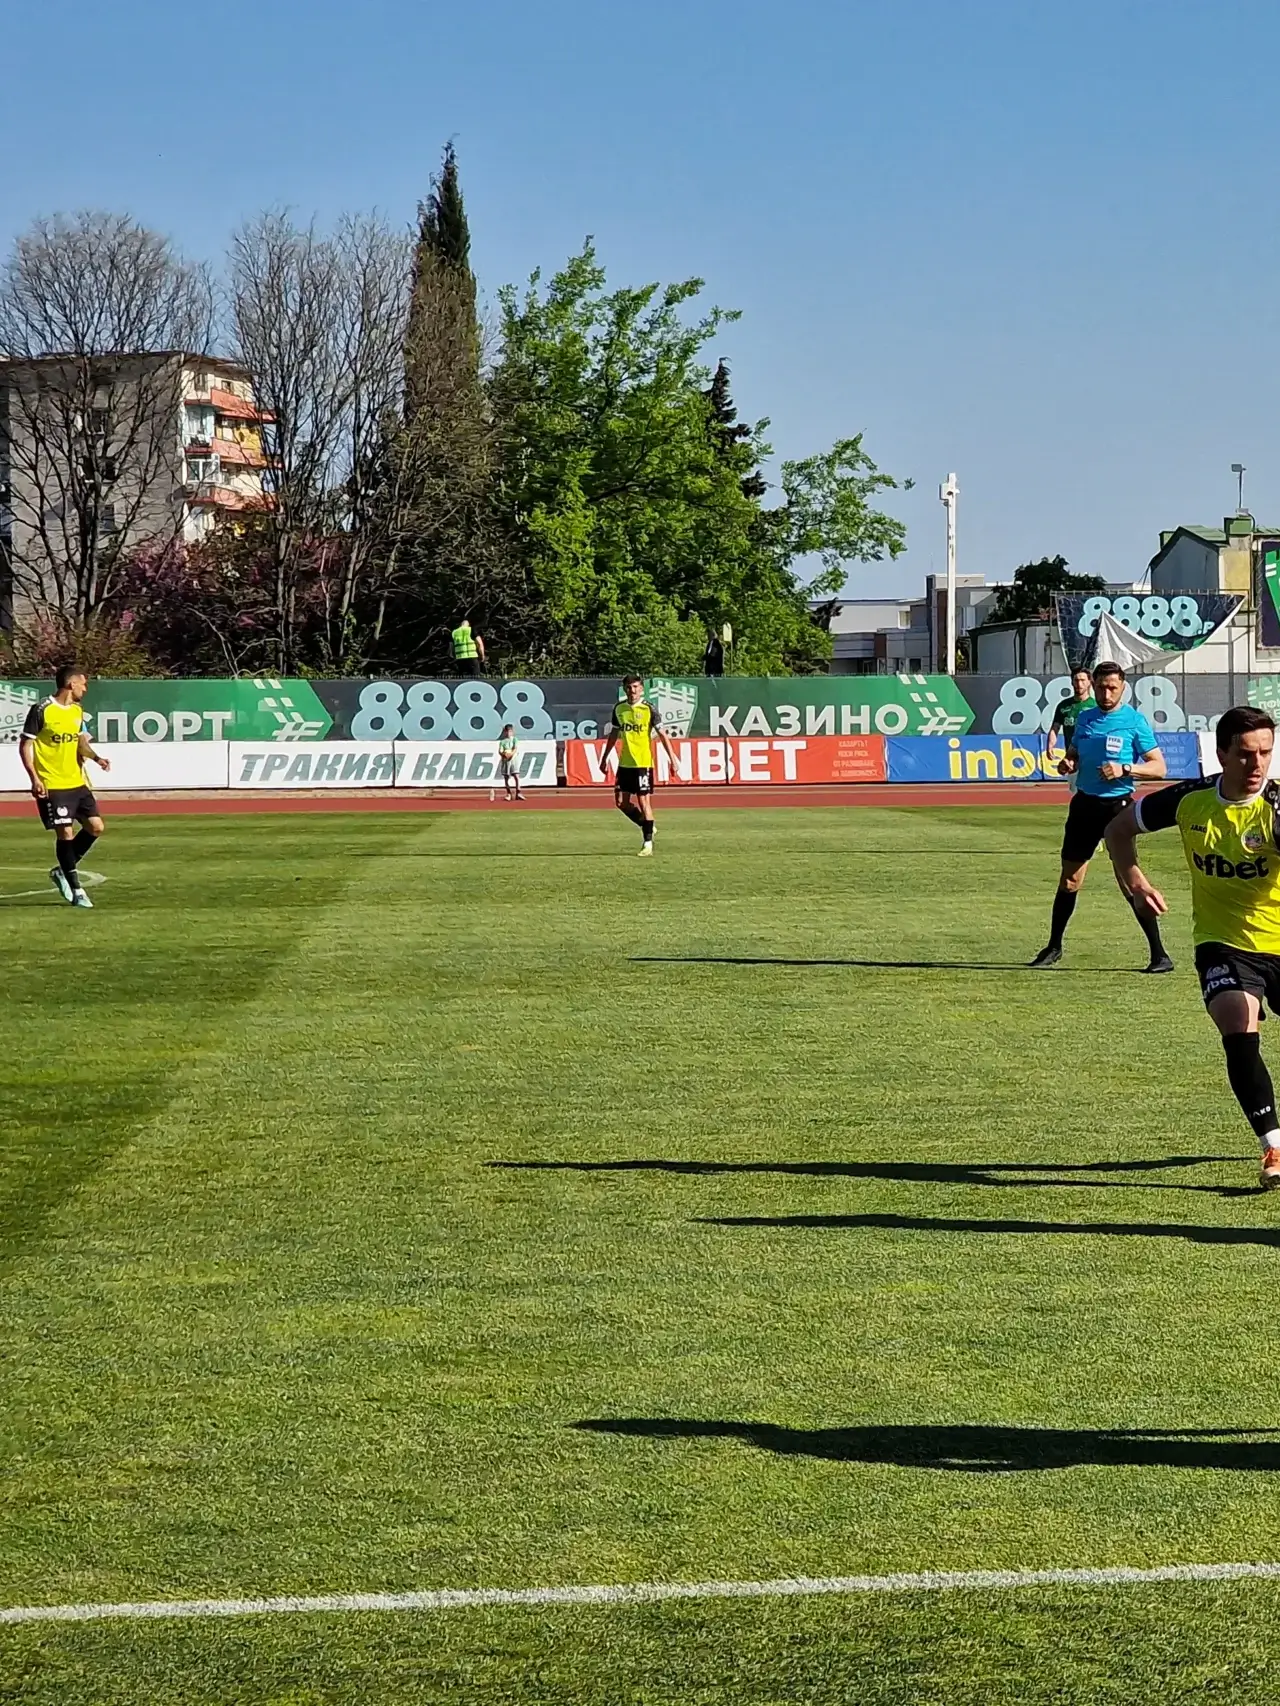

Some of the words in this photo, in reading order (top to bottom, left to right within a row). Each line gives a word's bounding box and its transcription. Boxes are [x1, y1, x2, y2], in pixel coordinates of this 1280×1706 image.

[351, 681, 598, 741] 8888.BG
[709, 703, 909, 737] КАЗИНО
[239, 753, 406, 782] ТРАКИЯ
[411, 752, 548, 781] КАБЛ
[583, 740, 807, 783] WNBET
[948, 737, 1067, 780] inbe
